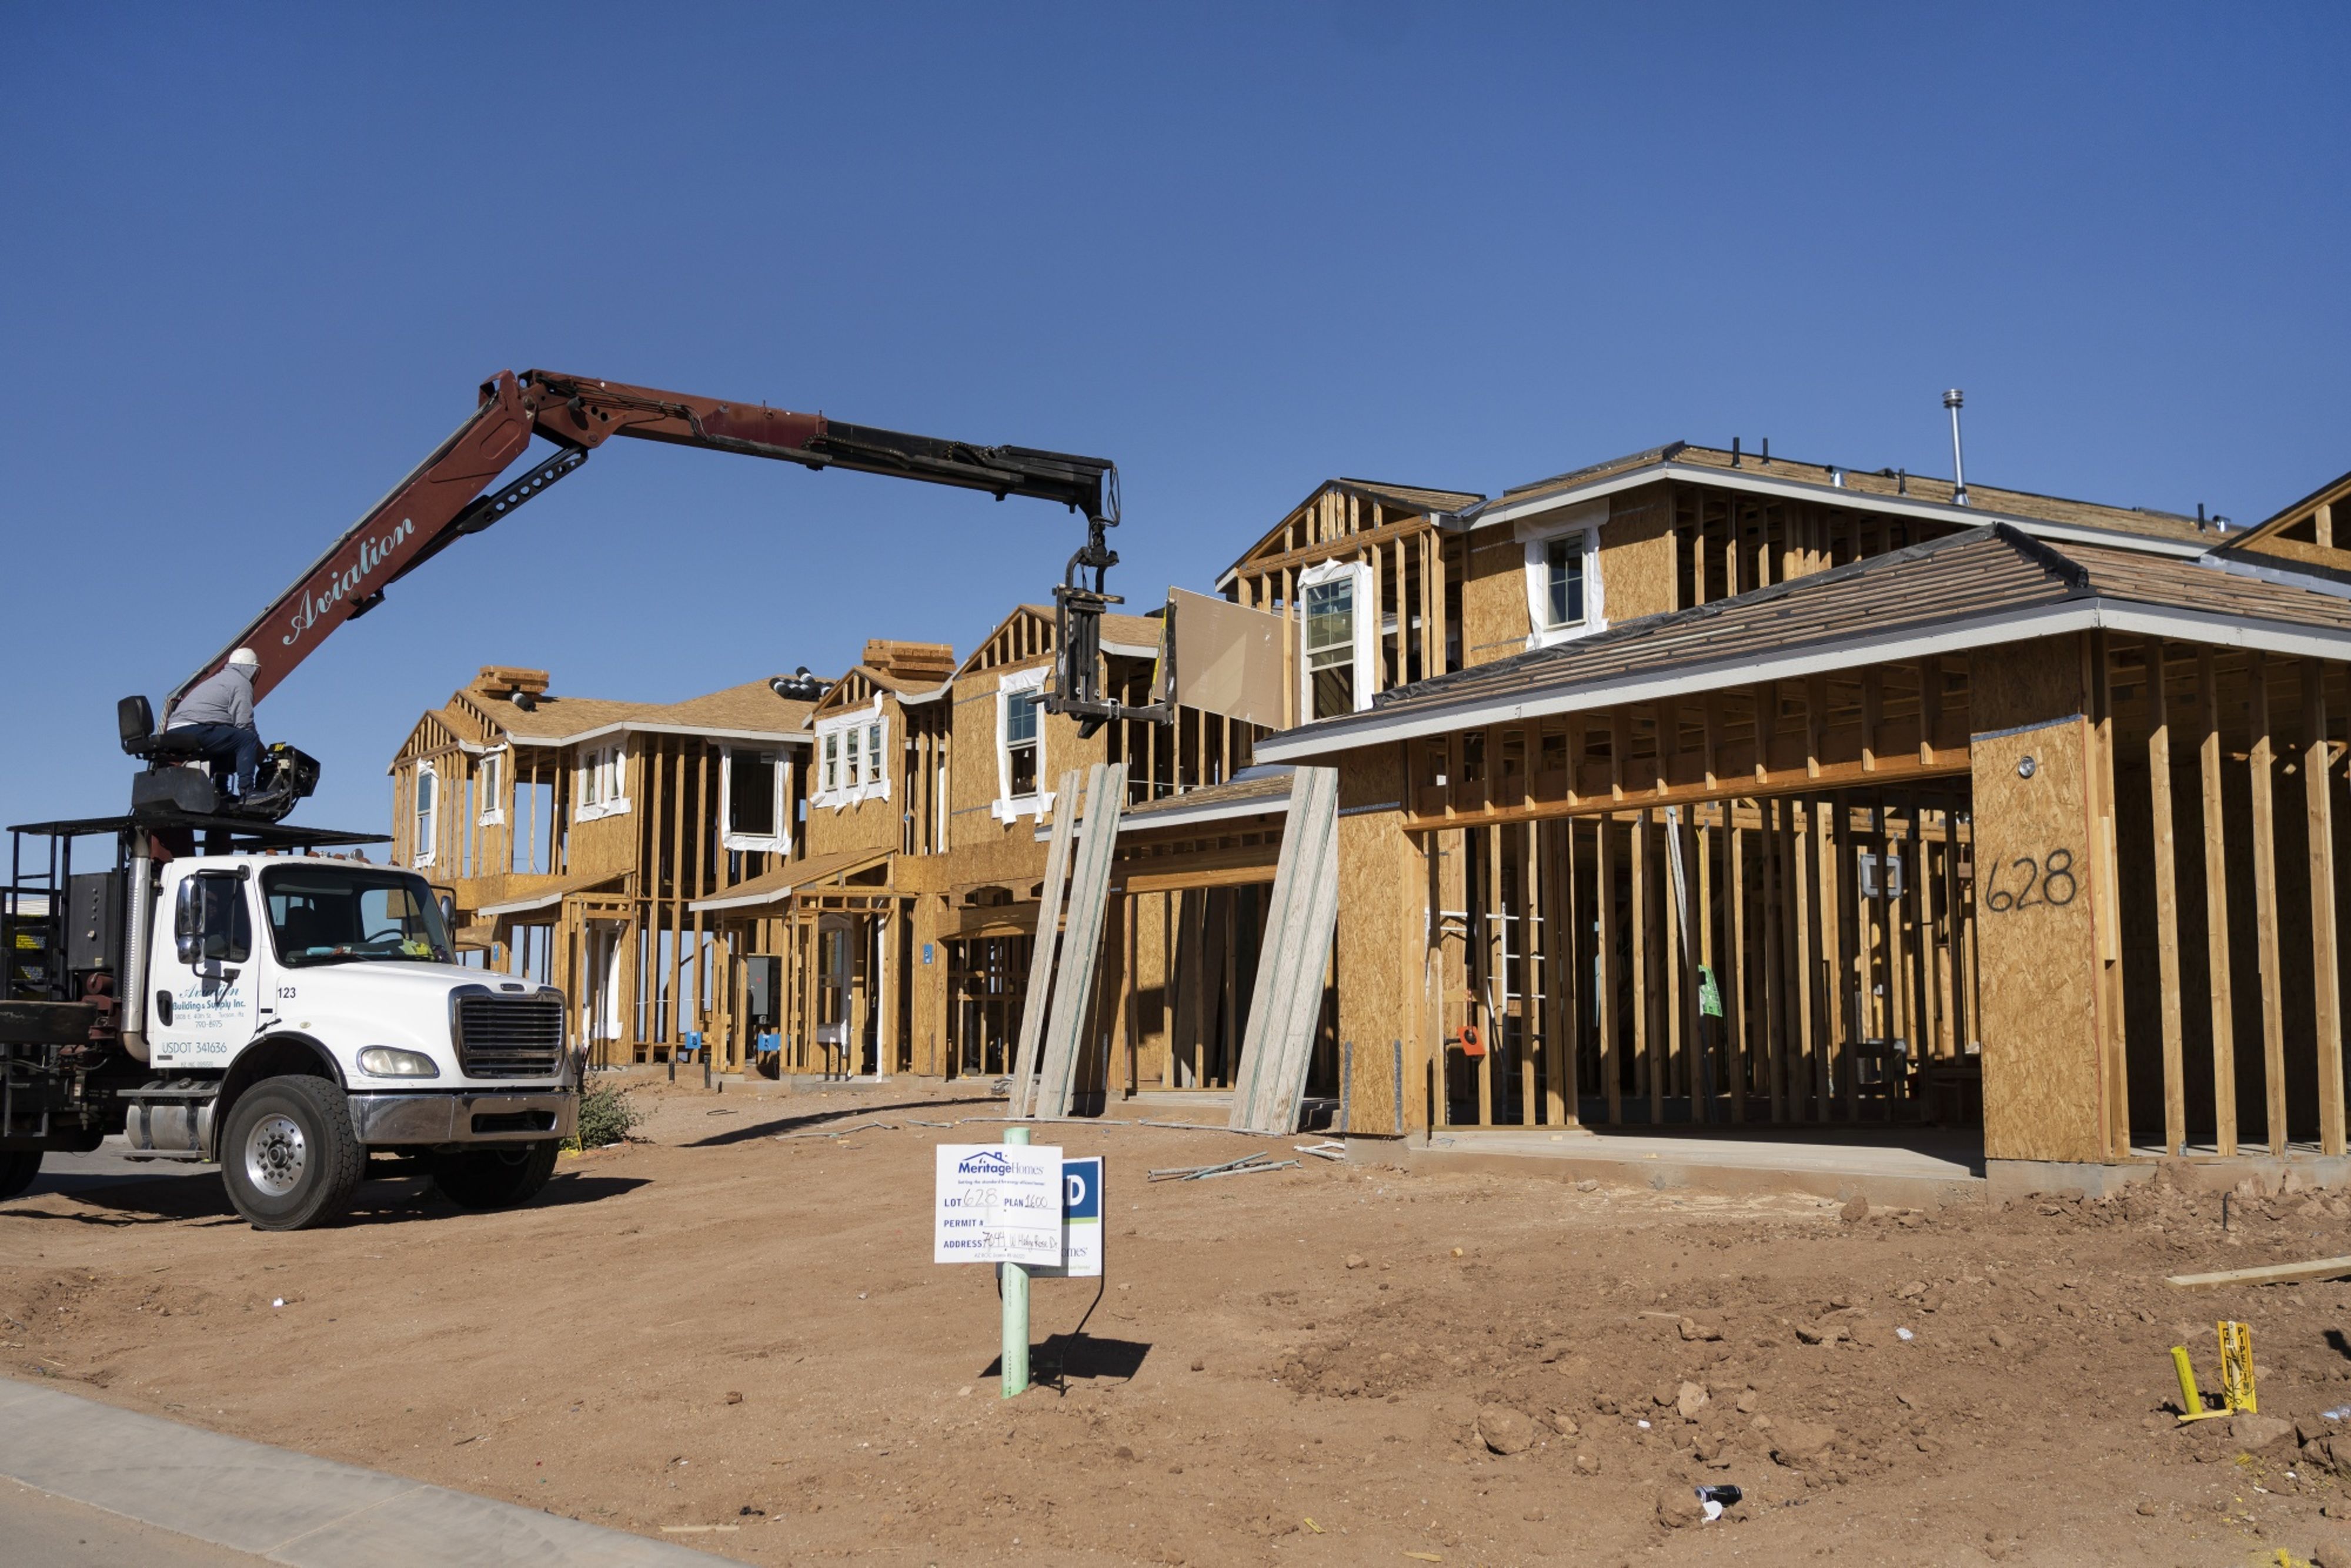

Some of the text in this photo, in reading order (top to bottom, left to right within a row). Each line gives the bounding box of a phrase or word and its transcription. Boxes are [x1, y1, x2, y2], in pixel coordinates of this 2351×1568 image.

[283, 518, 415, 645] Aviation
[1986, 848, 2076, 912] 628
[278, 987, 296, 998] 123
[173, 1001, 201, 1011] Building
[207, 1000, 231, 1011] Supply
[233, 999, 246, 1008] Inc.
[162, 1042, 227, 1054] USDOT 341636
[944, 1198, 961, 1207] LOT
[963, 1188, 998, 1206] 628
[1004, 1198, 1023, 1207] PLAN
[944, 1219, 976, 1228] PERMIT
[943, 1239, 982, 1248] ADDRESS
